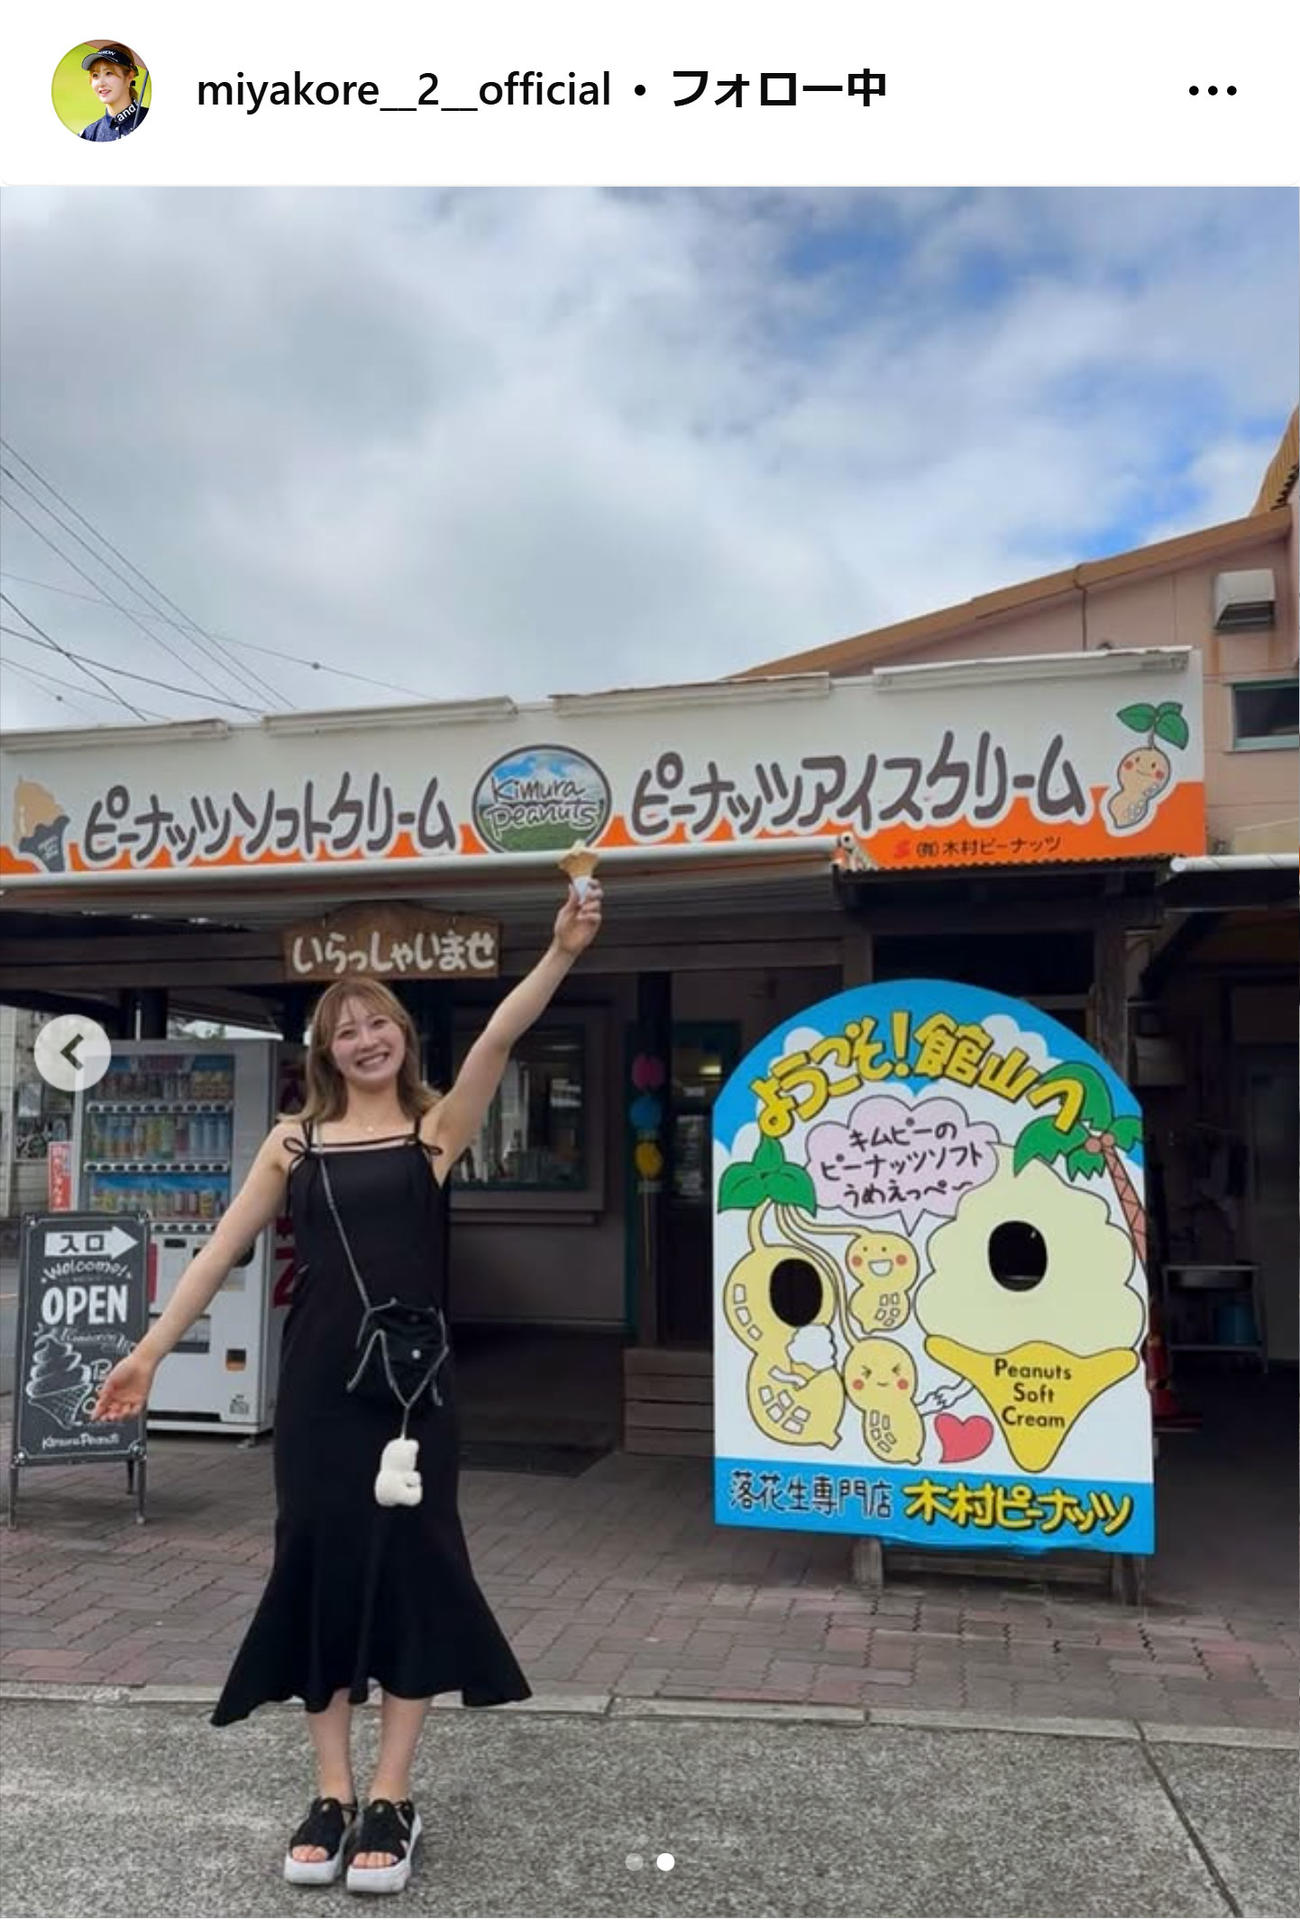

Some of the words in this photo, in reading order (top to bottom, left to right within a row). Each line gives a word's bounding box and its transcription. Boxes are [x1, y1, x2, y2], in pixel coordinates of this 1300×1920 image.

[490, 776, 586, 803] Kimura
[632, 730, 1086, 836] ピーナッツアイスクリーム
[84, 772, 457, 863] ピーナッツソフトクリーム
[293, 931, 496, 974] いらっしゃいませ
[850, 1117, 957, 1152] キムピーの
[820, 1141, 983, 1180] ピーナッツソフト
[60, 1233, 105, 1252] 入口
[42, 1285, 127, 1325] OPEN
[994, 1358, 1073, 1382] Peanuts
[1012, 1382, 1055, 1405] Soft
[1001, 1405, 1066, 1430] Cream
[902, 1478, 1132, 1535] 木村ピーナッツ
